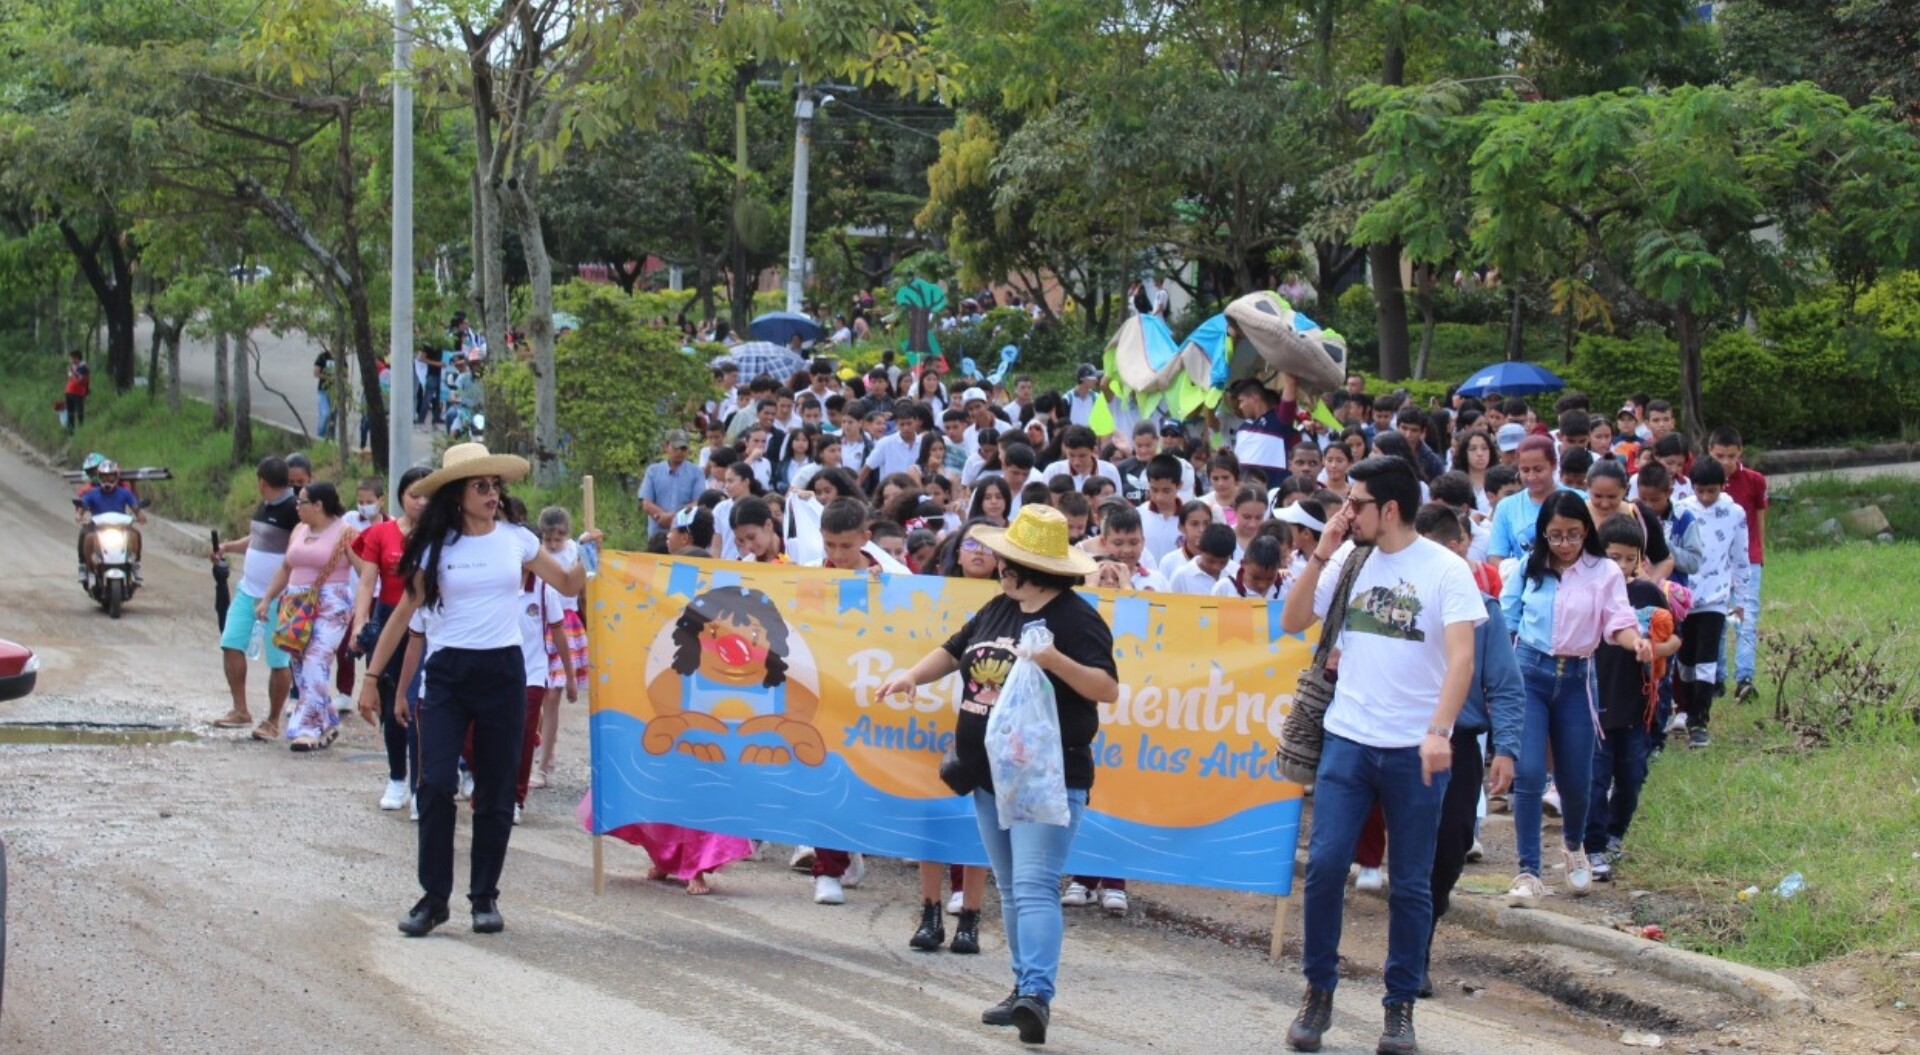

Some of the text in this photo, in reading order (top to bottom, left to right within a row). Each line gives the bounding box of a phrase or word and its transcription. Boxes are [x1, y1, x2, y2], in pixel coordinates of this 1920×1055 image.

[843, 714, 1285, 782] Ambie de las Arte
